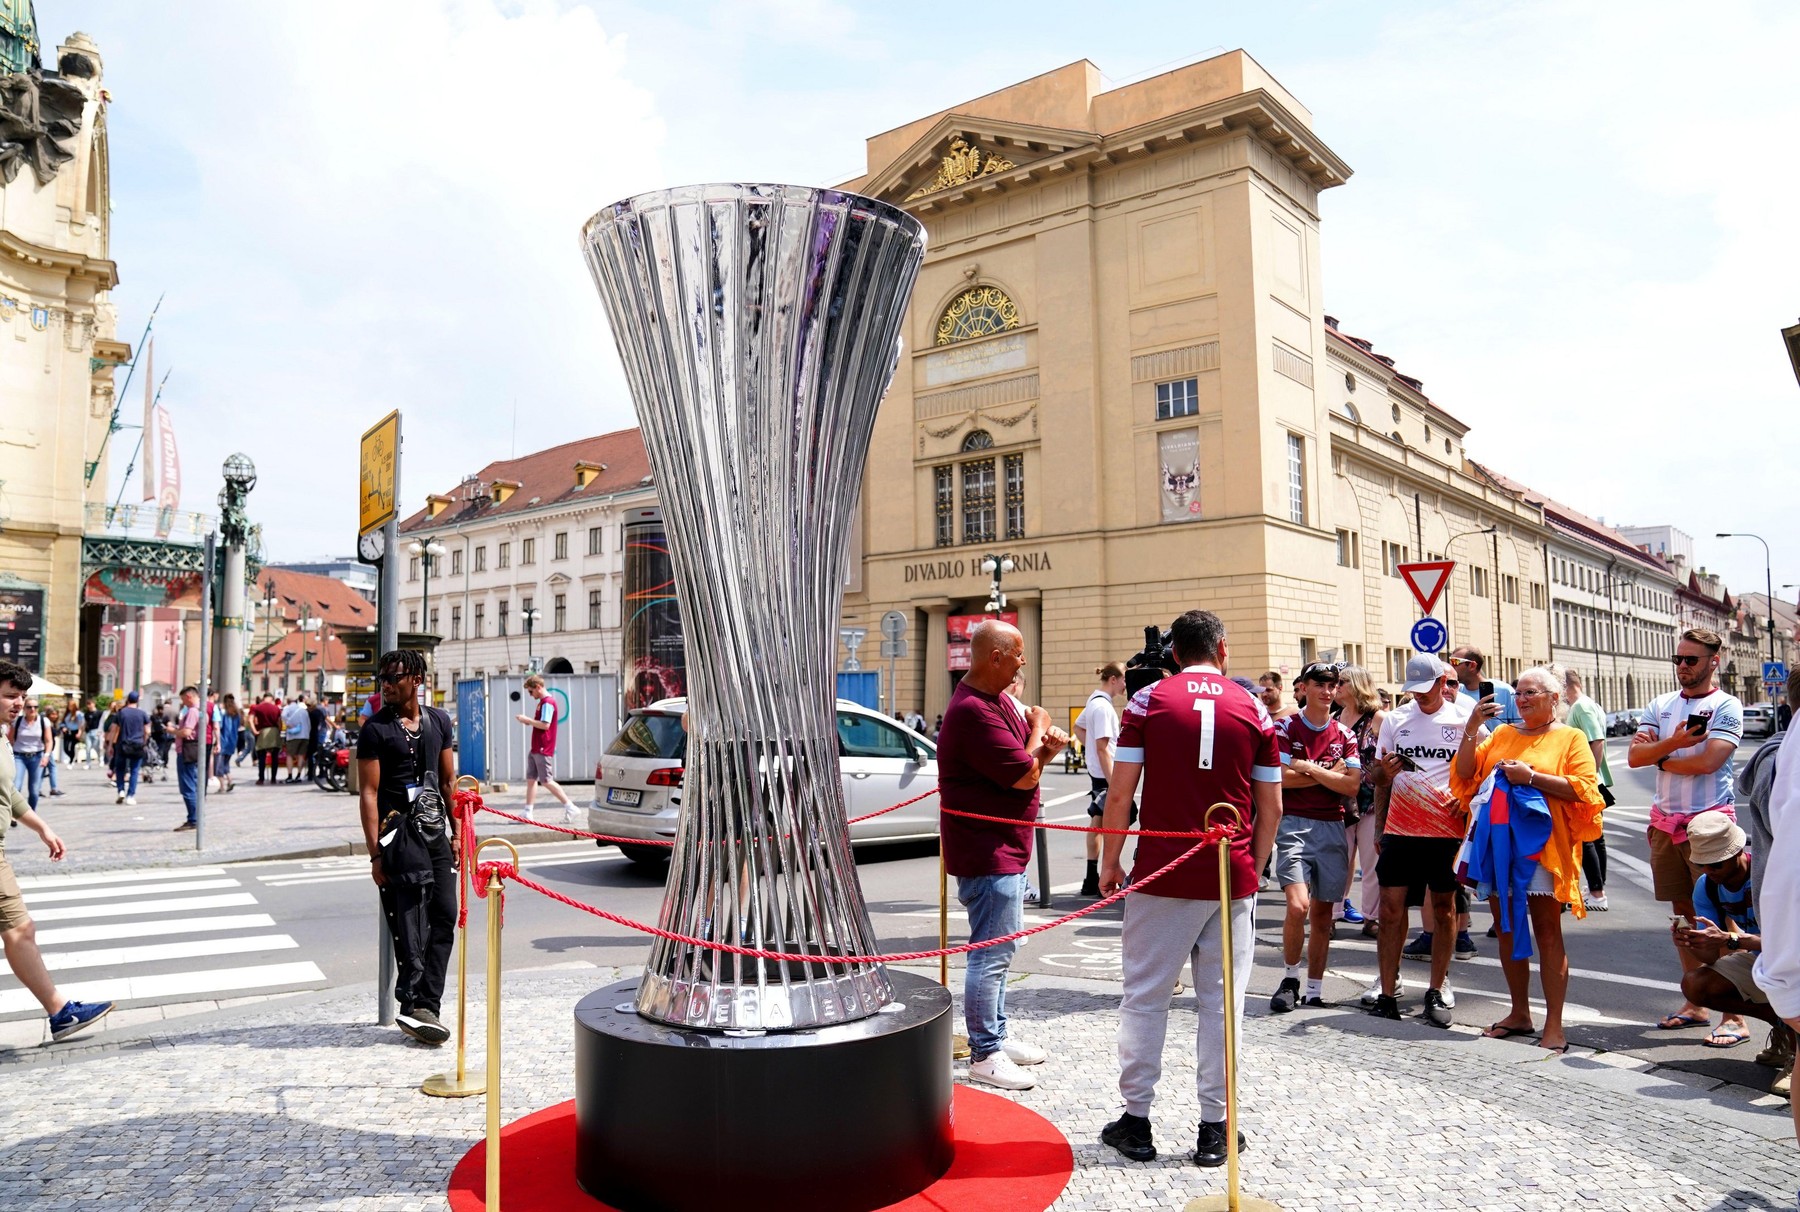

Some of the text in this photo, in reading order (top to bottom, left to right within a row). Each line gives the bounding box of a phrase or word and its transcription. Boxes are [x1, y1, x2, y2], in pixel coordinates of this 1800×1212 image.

[904, 551, 1051, 582] DIVADLO HRNIA
[1187, 681, 1223, 695] DAD
[1193, 698, 1215, 770] 1
[1396, 744, 1456, 763] betway
[690, 998, 785, 1023] UEFA
